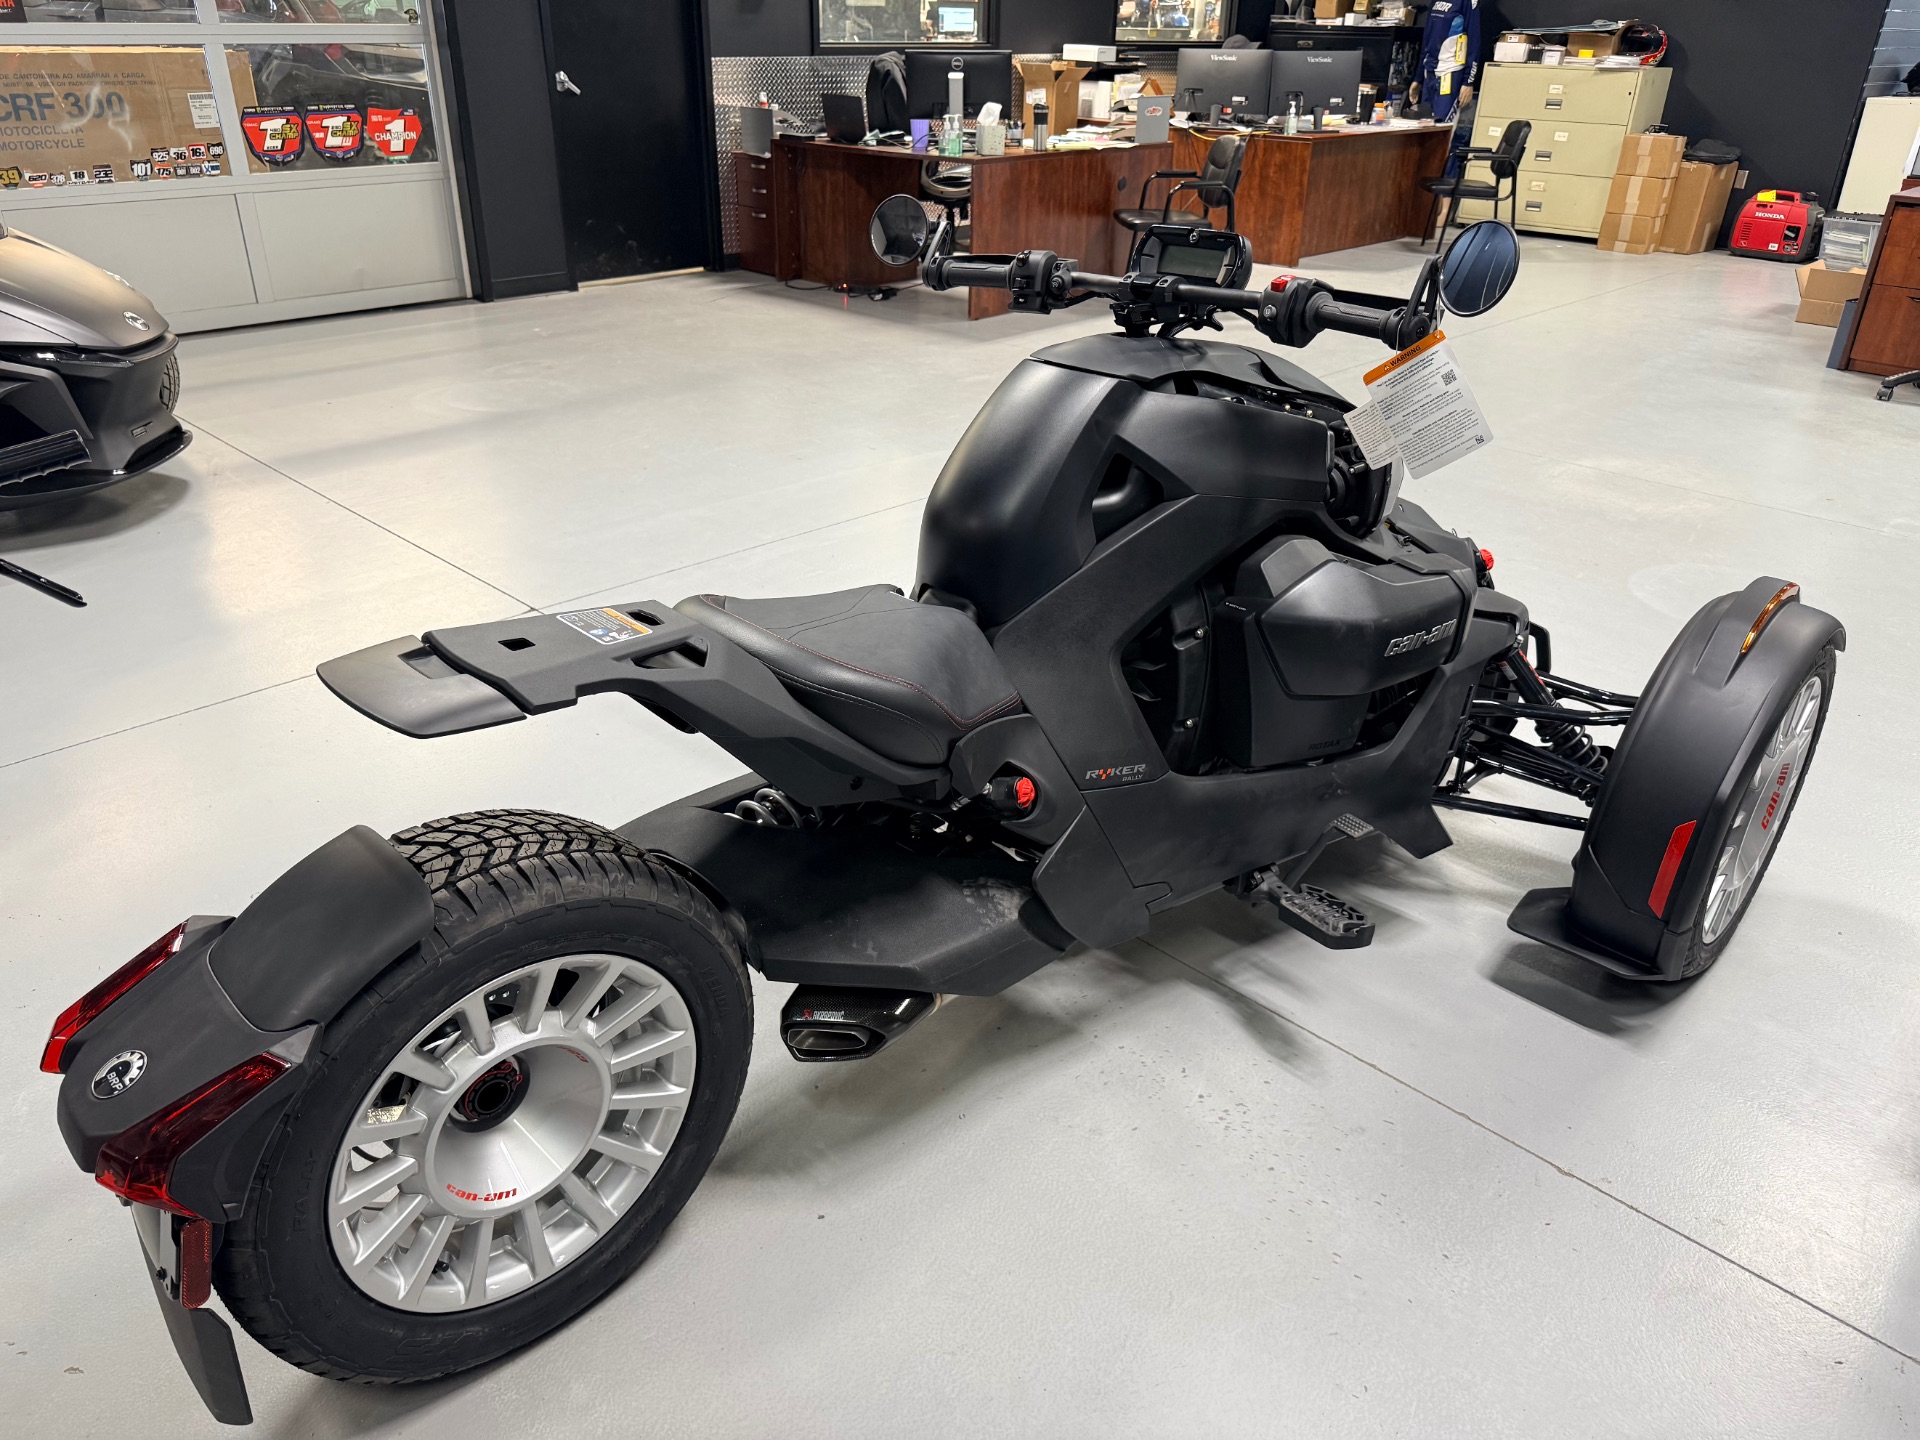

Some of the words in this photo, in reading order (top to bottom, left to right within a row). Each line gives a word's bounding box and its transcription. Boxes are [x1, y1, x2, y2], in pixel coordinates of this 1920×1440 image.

[1210, 54, 1238, 62] ViewSonic
[270, 132, 299, 140] CHAMP
[331, 129, 359, 138] CHAMP
[374, 131, 417, 141] CHAMPION
[173, 151, 187, 160] 36
[209, 146, 223, 155] 698
[152, 151, 169, 161] 925
[132, 162, 152, 177] 101
[72, 171, 86, 180] 18
[1755, 211, 1785, 220] HONDA
[1389, 344, 1421, 367] WARNING
[1383, 618, 1458, 657] can-am
[1085, 763, 1147, 781] RYKER
[1122, 774, 1144, 782] RALLY
[1761, 762, 1791, 831] can-am
[106, 1071, 124, 1091] BRP
[446, 1183, 517, 1201] can-am
